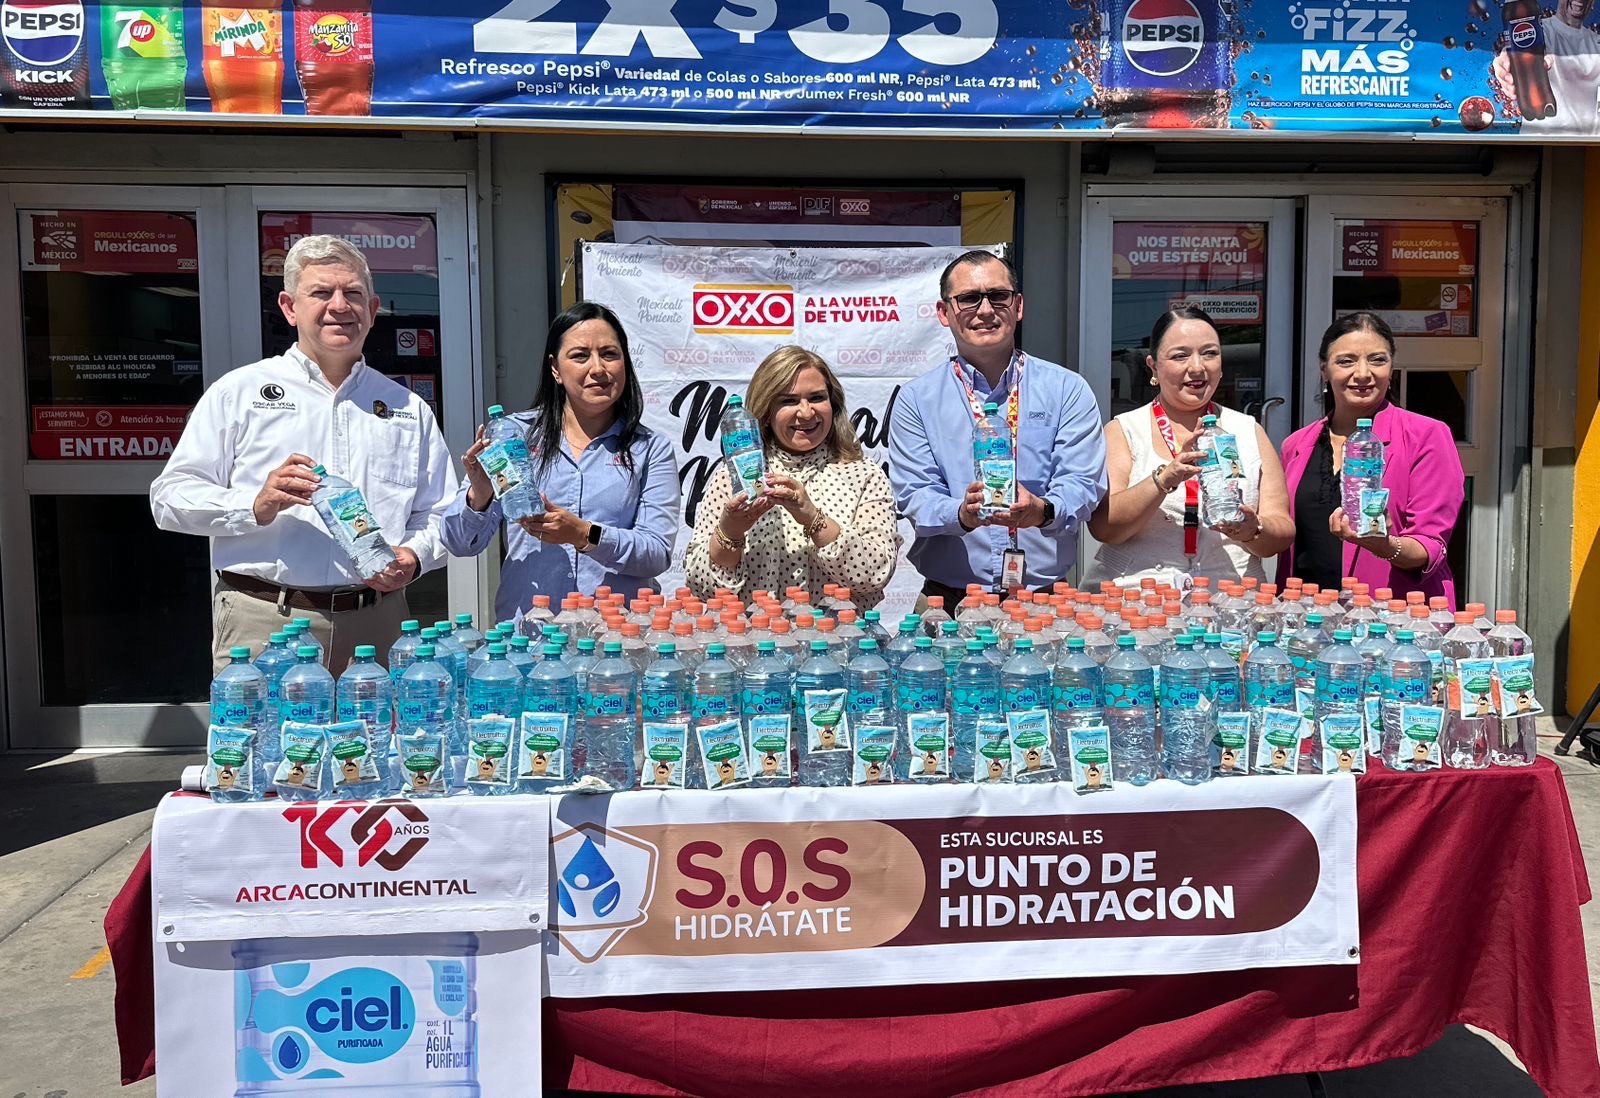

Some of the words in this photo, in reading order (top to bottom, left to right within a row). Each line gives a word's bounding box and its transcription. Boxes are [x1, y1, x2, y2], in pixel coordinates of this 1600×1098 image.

[5, 11, 81, 31] PEPSI
[308, 21, 359, 35] Manzanita
[1126, 24, 1200, 43] PEPSI
[1514, 29, 1536, 40] PEPSI
[1302, 44, 1410, 74] MÁS
[15, 69, 75, 84] KICK
[440, 58, 536, 76] Refresco
[543, 60, 611, 81] Pepsi®
[615, 67, 680, 82] Variedad
[684, 70, 702, 82] de
[706, 71, 747, 83] Colas
[750, 74, 760, 83] o
[764, 72, 821, 84] Sabores
[825, 73, 853, 84] 600
[857, 73, 875, 84] ml
[879, 73, 903, 86] NR,
[955, 76, 985, 88] Lata
[989, 77, 1015, 88] 473
[1301, 75, 1410, 96] REFRESCANTE
[516, 81, 565, 95] Pepsi®
[569, 83, 601, 96] Kick
[604, 84, 637, 97] Lata
[640, 86, 668, 98] 473
[672, 87, 690, 98] ml
[693, 90, 703, 98] o
[706, 88, 734, 99] 500
[738, 88, 756, 100] ml
[760, 89, 781, 100] NR
[797, 89, 844, 100] Jumex
[848, 89, 893, 101] Fresh®
[896, 91, 924, 102] 600
[927, 91, 946, 103] ml
[949, 92, 970, 103] NR
[840, 201, 870, 213] OXXO
[94, 240, 178, 253] Mexicanos
[1137, 236, 1168, 248] NOS
[1171, 236, 1240, 248] ENCANTA
[41, 250, 77, 260] MÉXICO
[1128, 251, 1159, 265] QUE
[1162, 248, 1209, 263] ESTÉS
[1211, 249, 1248, 266] AQUÍ
[1392, 248, 1460, 260] Mexicanos
[1348, 258, 1378, 266] MÉXICO
[637, 296, 683, 311] Mexicali
[805, 297, 816, 307] A
[820, 297, 841, 308] LA
[841, 296, 898, 308] VUELTA
[695, 291, 792, 327] OXXO
[637, 309, 682, 323] Poniente
[805, 310, 827, 323] DE
[830, 310, 859, 323] TU
[859, 310, 900, 323] VIDA
[664, 348, 709, 365] OXXO
[837, 348, 882, 364] OXXO
[69, 411, 86, 419] PARA
[120, 415, 154, 424] Atención
[155, 415, 164, 424] 24
[60, 437, 175, 457] ENTRADA
[1340, 685, 1359, 695] ciel
[1405, 683, 1425, 694] ciel
[764, 695, 783, 706] ciel
[921, 693, 939, 703] ciel
[1017, 693, 1037, 703] ciel
[1073, 691, 1093, 701] ciel
[1179, 690, 1199, 700] ciel
[538, 702, 557, 712] ciel
[603, 698, 623, 708] ciel
[658, 698, 677, 708] ciel
[707, 699, 727, 709] ciel
[226, 707, 247, 718] ciel
[291, 706, 313, 717] ciel
[403, 704, 421, 715] ciel
[394, 823, 430, 836] AÑOS
[940, 832, 982, 848] ESTA
[985, 830, 1079, 847] SUCURSAL
[1083, 829, 1104, 845] ES
[940, 853, 1092, 889] PUNTO
[1101, 850, 1157, 884] DE
[235, 879, 477, 903] ARCACONTINENTAL
[939, 877, 1235, 928] HIDRATACIÓN
[674, 902, 852, 940] HIDRÁTATE
[337, 1038, 384, 1049] PURIFICADA
[426, 1036, 452, 1052] AGUA
